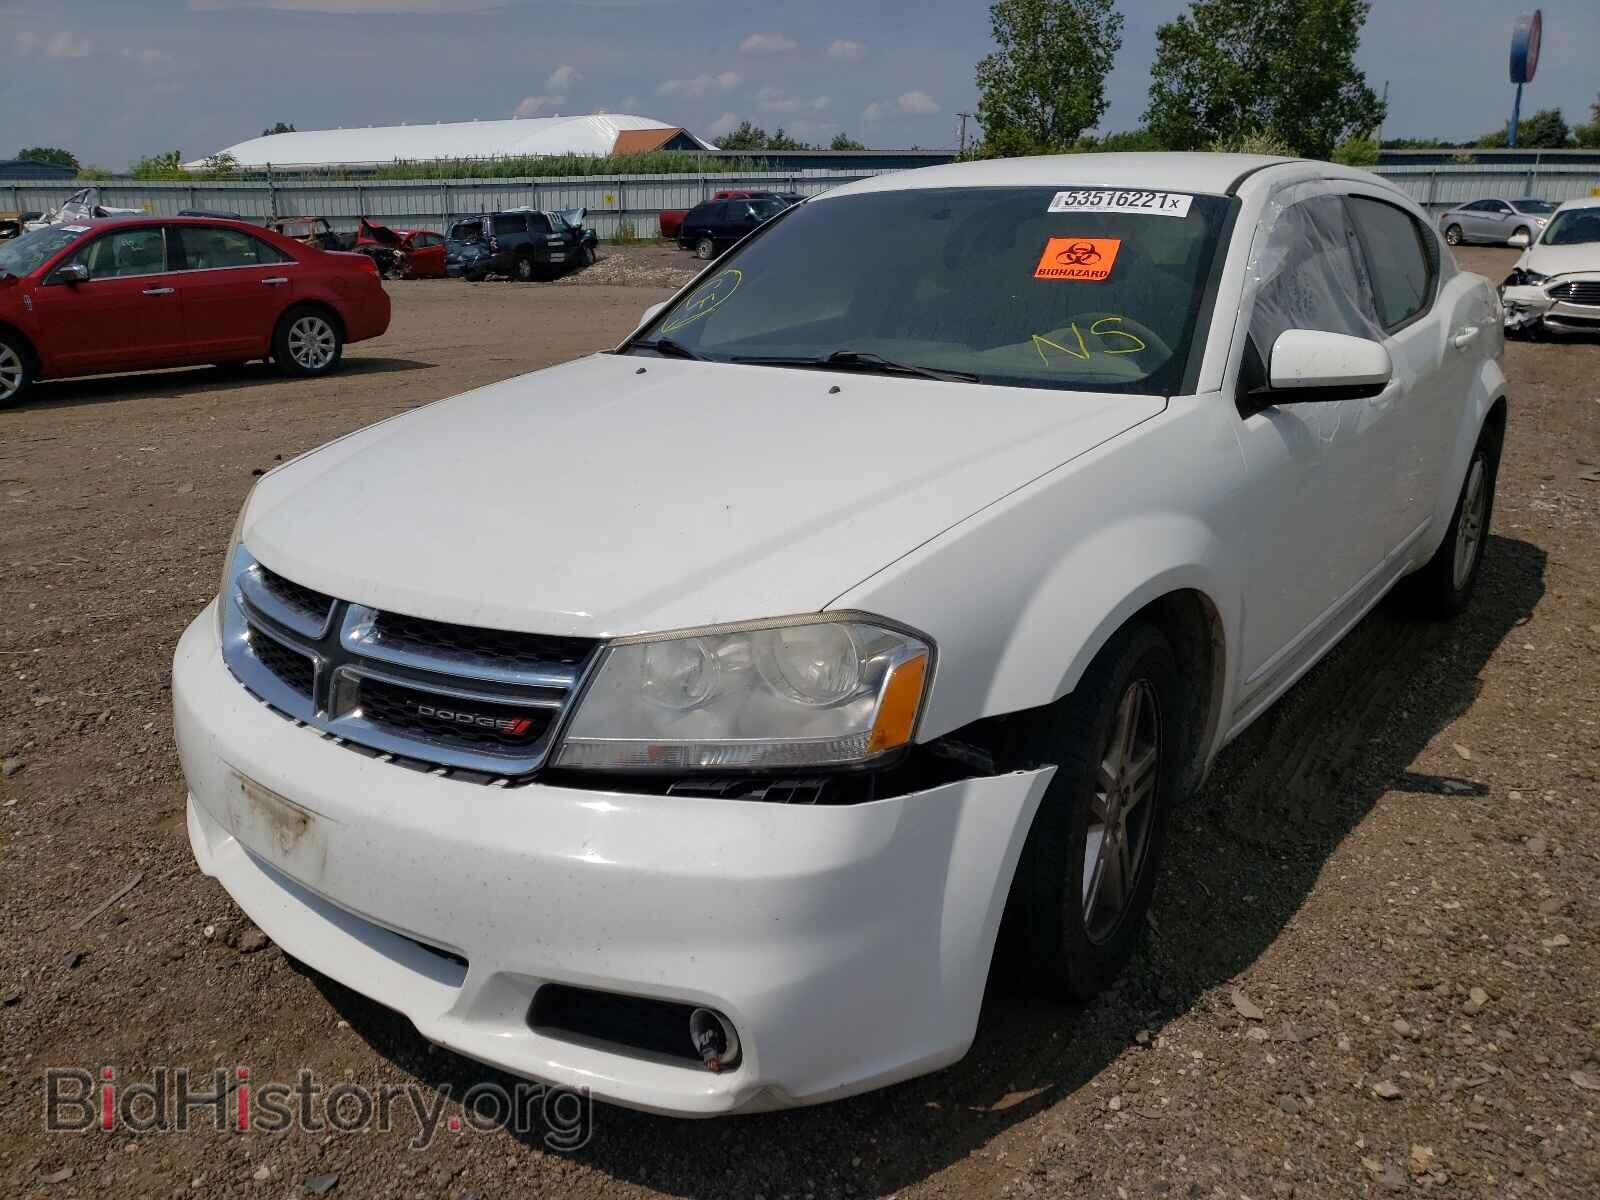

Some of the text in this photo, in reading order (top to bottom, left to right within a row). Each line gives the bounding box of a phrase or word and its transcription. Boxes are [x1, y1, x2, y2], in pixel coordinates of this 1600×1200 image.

[1037, 268, 1109, 278] BIOHAZARD
[1031, 316, 1147, 368] NS
[418, 704, 516, 731] DODGE
